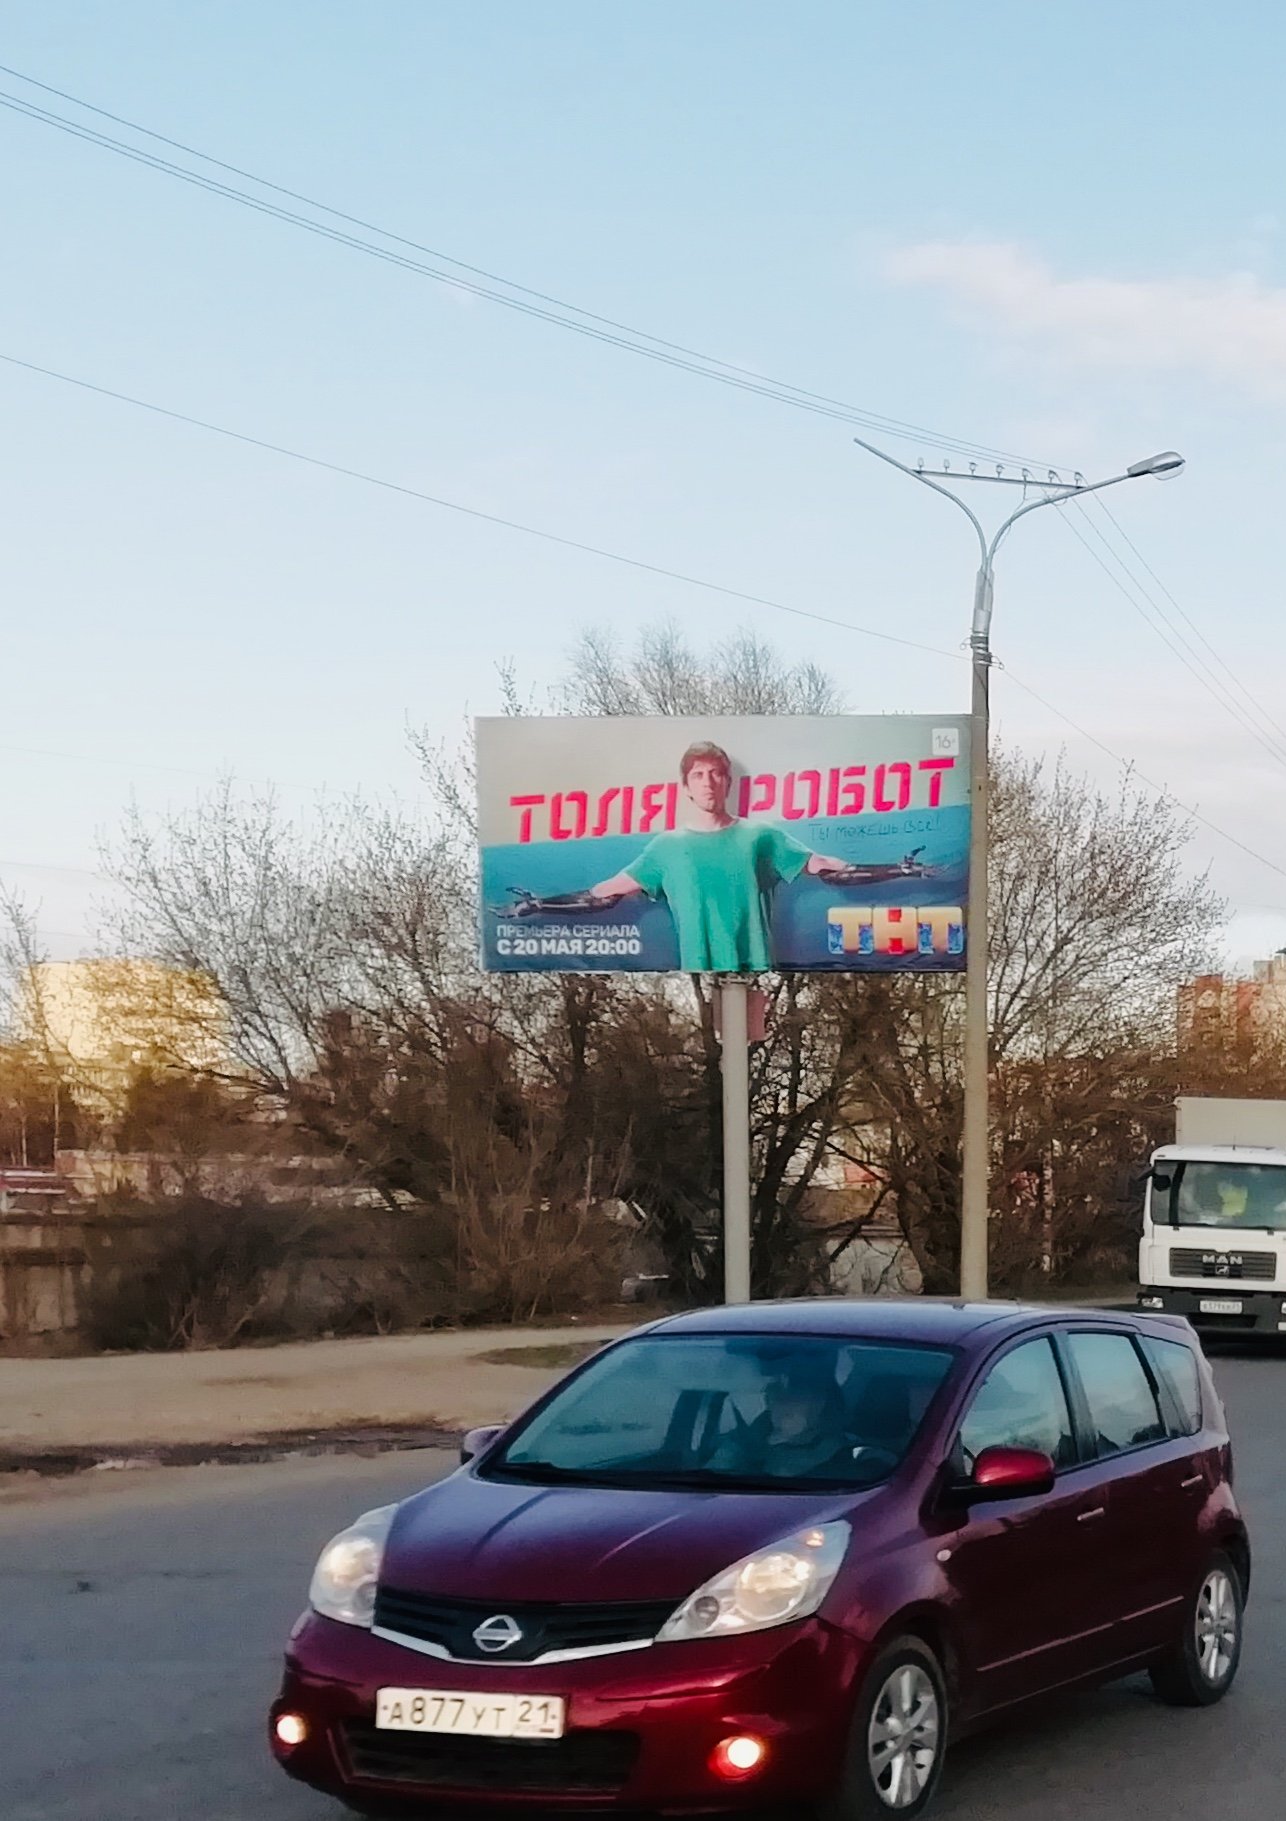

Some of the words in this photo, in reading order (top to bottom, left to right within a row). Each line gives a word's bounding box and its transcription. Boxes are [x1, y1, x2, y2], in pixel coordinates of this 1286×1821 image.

[510, 782, 678, 844] ТОЛЯ
[738, 757, 955, 820] РОБОТ
[496, 925, 570, 938] ПРЕМЬЕРА
[573, 925, 640, 938] СЕРИАЛА
[827, 906, 963, 954] ТНТ
[497, 939, 511, 955] С
[513, 939, 538, 955] 20
[541, 939, 582, 955] МАЯ
[585, 939, 641, 955] 20:00
[1202, 1254, 1243, 1265] MAN
